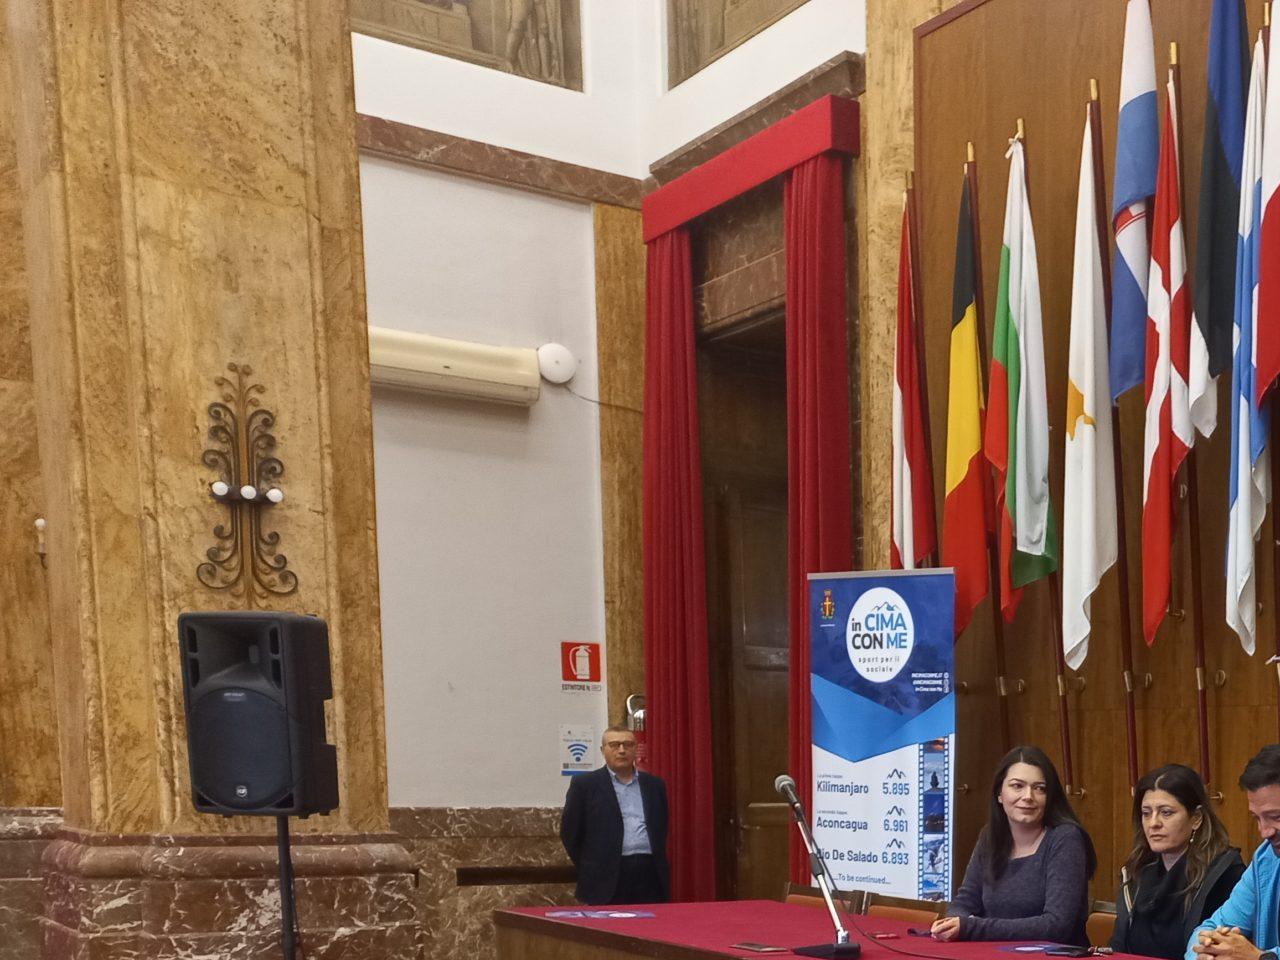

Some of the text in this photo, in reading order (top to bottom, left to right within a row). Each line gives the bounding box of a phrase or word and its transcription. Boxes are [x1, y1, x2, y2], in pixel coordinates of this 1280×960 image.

[852, 613, 907, 631] in CIMA
[852, 632, 907, 650] CON ME
[817, 780, 910, 796] Kilimanjaro 5.895
[817, 816, 908, 832] Aconcagua 6.961
[832, 849, 845, 860] De
[847, 850, 878, 863] Salado
[881, 851, 909, 865] 6.893
